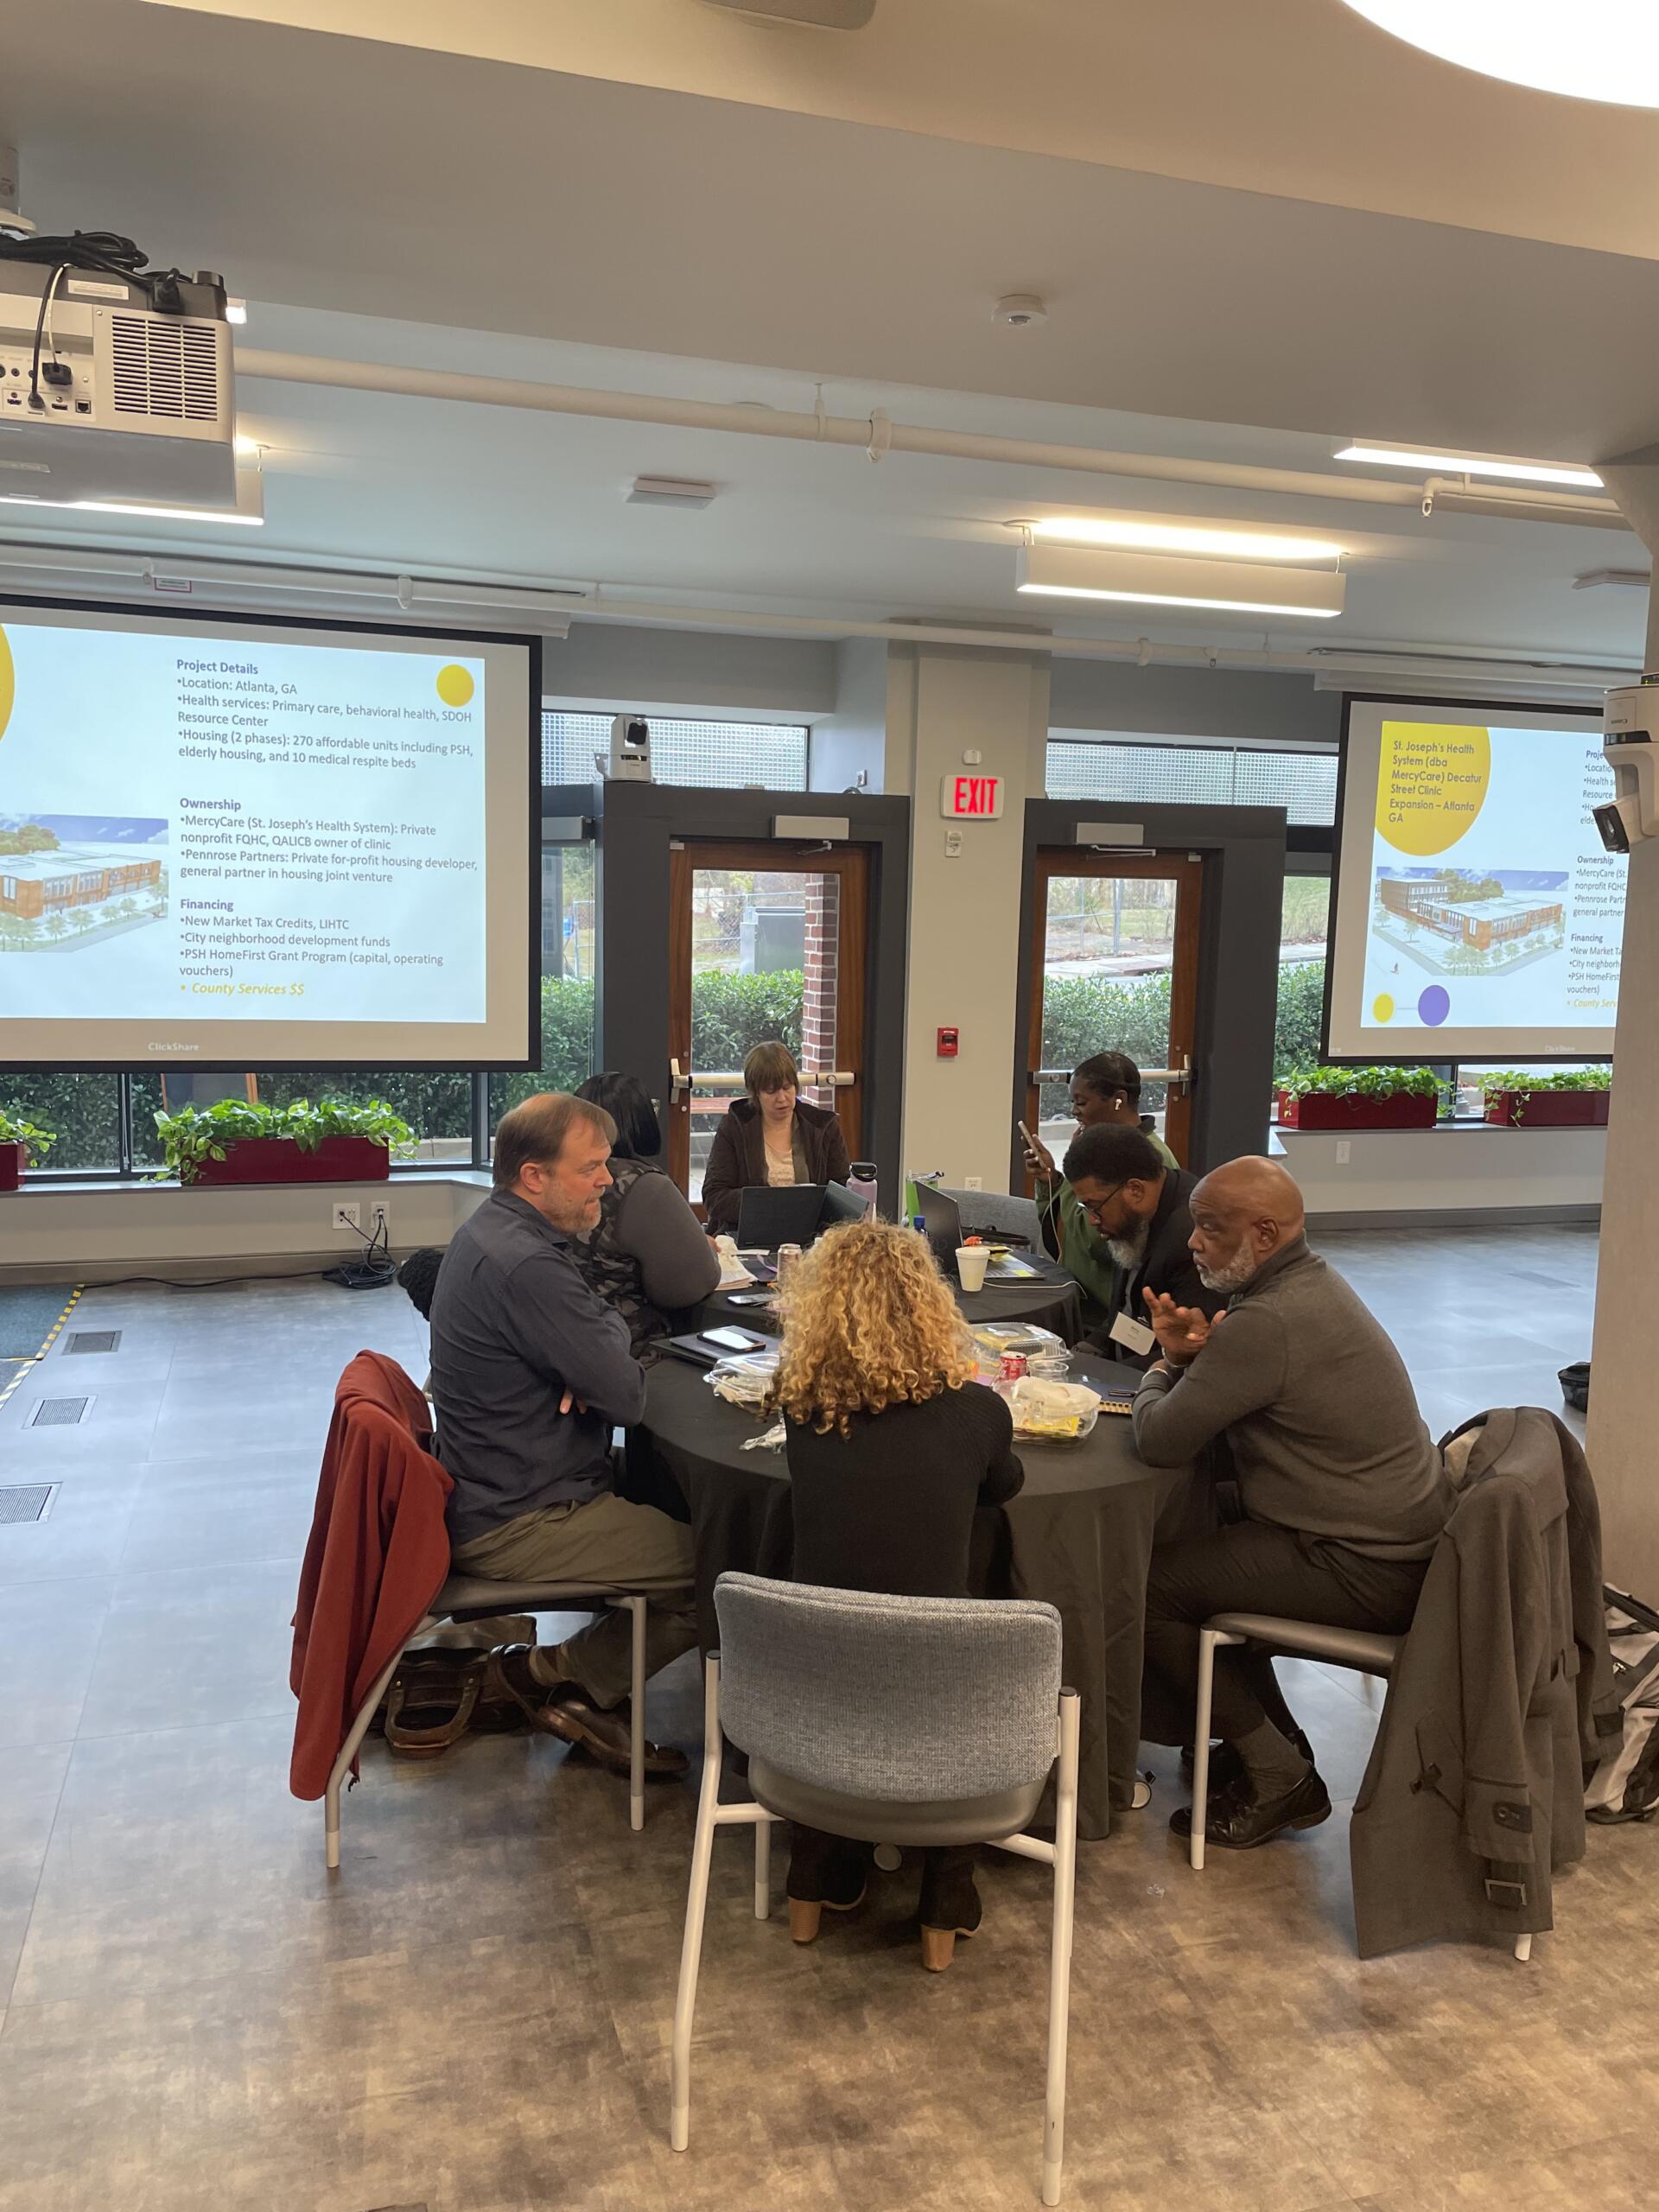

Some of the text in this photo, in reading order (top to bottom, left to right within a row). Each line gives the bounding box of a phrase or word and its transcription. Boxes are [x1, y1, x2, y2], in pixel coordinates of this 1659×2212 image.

[177, 659, 258, 674] Project Details
[182, 677, 297, 695] Location: Atlanta, GA
[182, 695, 472, 722] Health services: Primary care, behavioral health, SDOH
[178, 712, 268, 726] Resource Center
[183, 729, 473, 756] Housing (2 phases): 270 affordable units including PSH,
[1394, 741, 1474, 753] St. Joseph's Health
[179, 747, 416, 768] elderly housing, and 10 medical respite beds
[1393, 755, 1447, 768] System (dba
[1586, 750, 1604, 760] Proje
[1392, 770, 1482, 783] MercyCare) Decatur
[1586, 777, 1609, 785] Health
[955, 778, 998, 814] EXIT
[1391, 785, 1441, 795] Street Clinic
[1583, 790, 1612, 798] Resource
[180, 798, 241, 812] Ownership
[1389, 798, 1433, 810] Expansion
[1443, 801, 1474, 810] Atlanta
[1389, 813, 1403, 823] GA
[185, 816, 435, 836] MercyCare (St. Joseph's Health System): Private
[181, 833, 391, 849] nonprofit FQHC, QALICB owner of clinic
[186, 849, 477, 871] Pennrose Partners: Private for-profit housing developer,
[1578, 855, 1613, 865] Ownership
[181, 867, 392, 882] general partner in housing joint venture
[1579, 869, 1614, 878] MercyCare
[1575, 882, 1606, 891] nonprofit
[181, 899, 234, 912] Financing
[1573, 908, 1624, 918] general partner
[185, 916, 349, 930] New Market Tax Credits, LIHTC
[185, 932, 391, 947] City neighborhood development funds
[1571, 933, 1603, 944] Financing
[185, 949, 443, 966] PSH HomeFirst Grant Program (capital, operating
[1573, 960, 1621, 969] City neighborh
[180, 966, 233, 978] vouchers)
[1571, 972, 1584, 981] PSH
[192, 982, 304, 995] County Services $$
[1567, 985, 1599, 995] vouchers)
[1573, 1000, 1599, 1008] County
[148, 1042, 199, 1051] ClickShare
